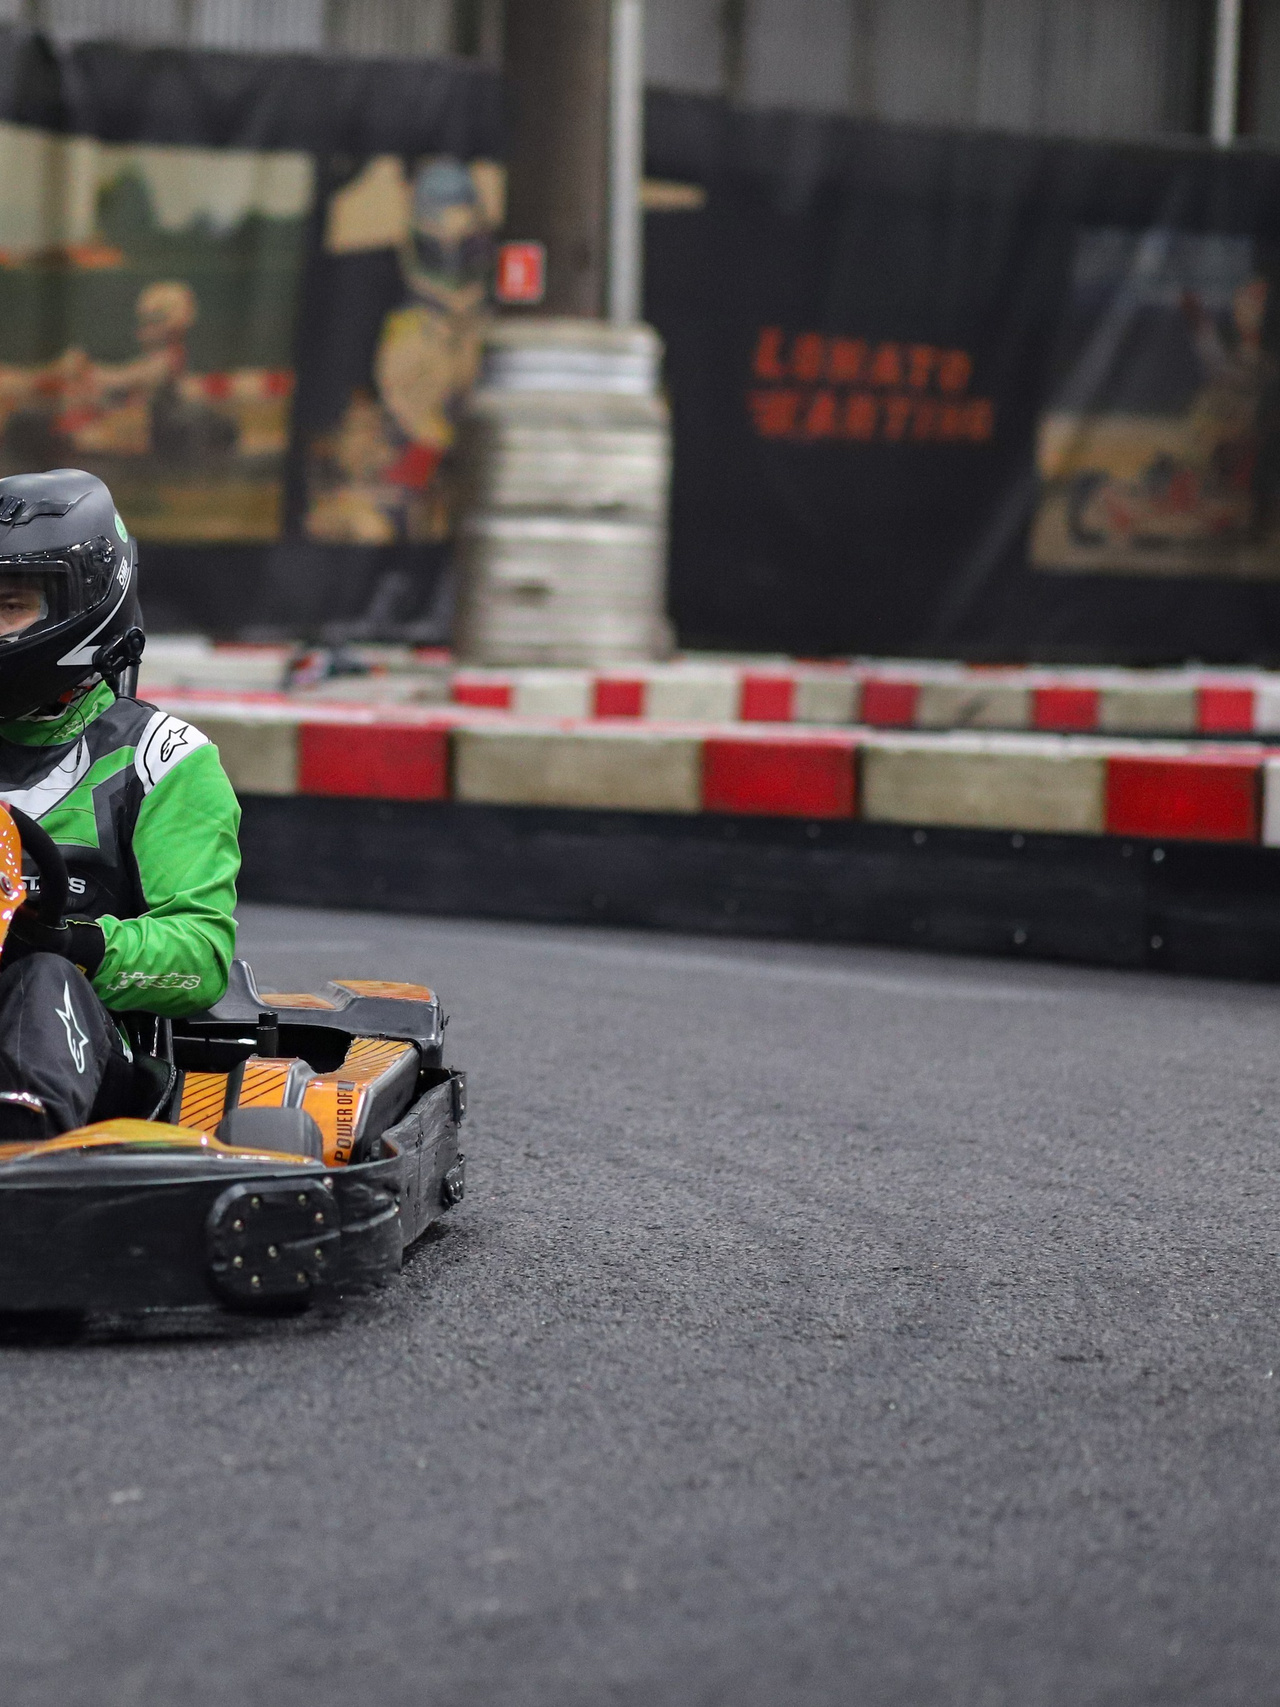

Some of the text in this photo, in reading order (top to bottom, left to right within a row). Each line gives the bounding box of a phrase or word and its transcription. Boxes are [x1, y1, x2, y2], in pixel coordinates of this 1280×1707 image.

[752, 327, 973, 392] LONATO
[337, 1092, 352, 1104] OF
[334, 1108, 352, 1162] POWER
